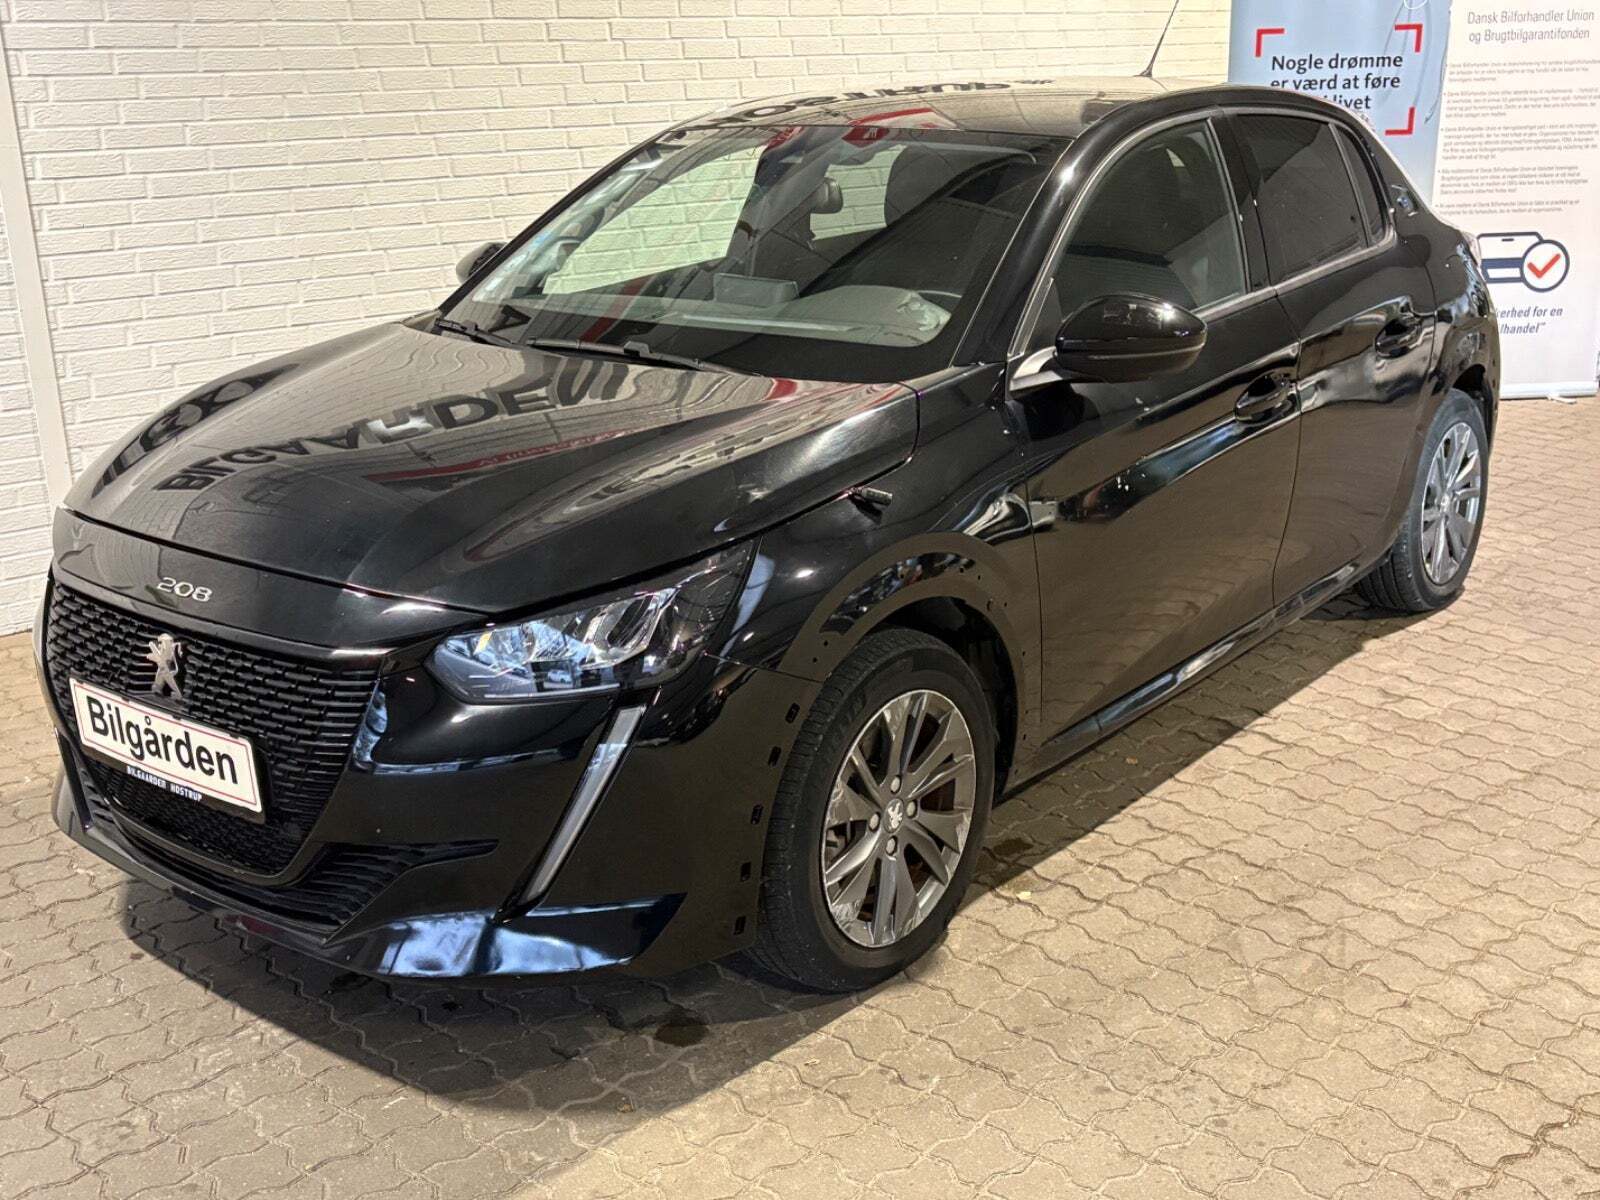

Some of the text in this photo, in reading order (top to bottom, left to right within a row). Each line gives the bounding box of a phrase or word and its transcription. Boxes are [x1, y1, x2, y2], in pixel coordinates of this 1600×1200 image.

[1467, 8, 1595, 24] Dansk Bilforhandler Union
[1468, 27, 1590, 44] og Brugtbilgarantifonden
[1272, 53, 1403, 73] Nogle drømme
[1270, 73, 1401, 90] er værd at føre
[1533, 305, 1548, 317] for
[1550, 308, 1563, 317] en
[157, 576, 213, 603] 208
[86, 695, 238, 784] Bilgården
